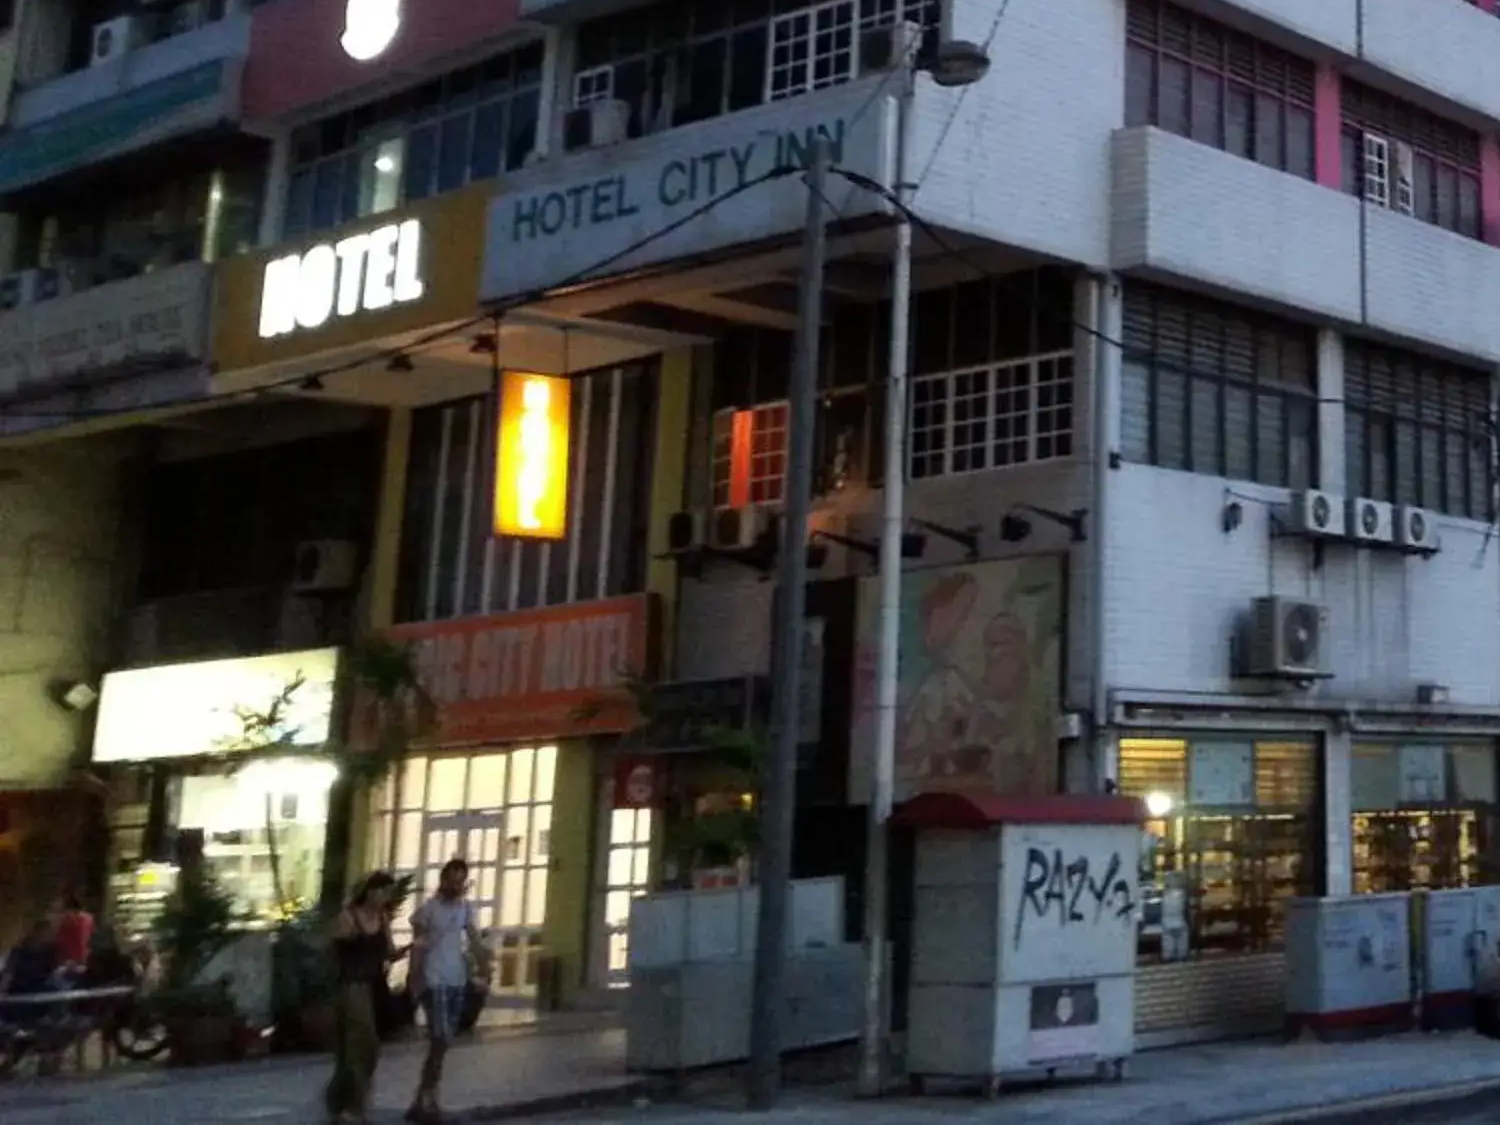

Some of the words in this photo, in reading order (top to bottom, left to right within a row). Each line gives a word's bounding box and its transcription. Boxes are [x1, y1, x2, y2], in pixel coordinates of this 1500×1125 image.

[511, 175, 639, 241] HOTEL
[658, 142, 757, 207] CITY
[774, 118, 845, 169] INN
[259, 218, 422, 338] HOTEL
